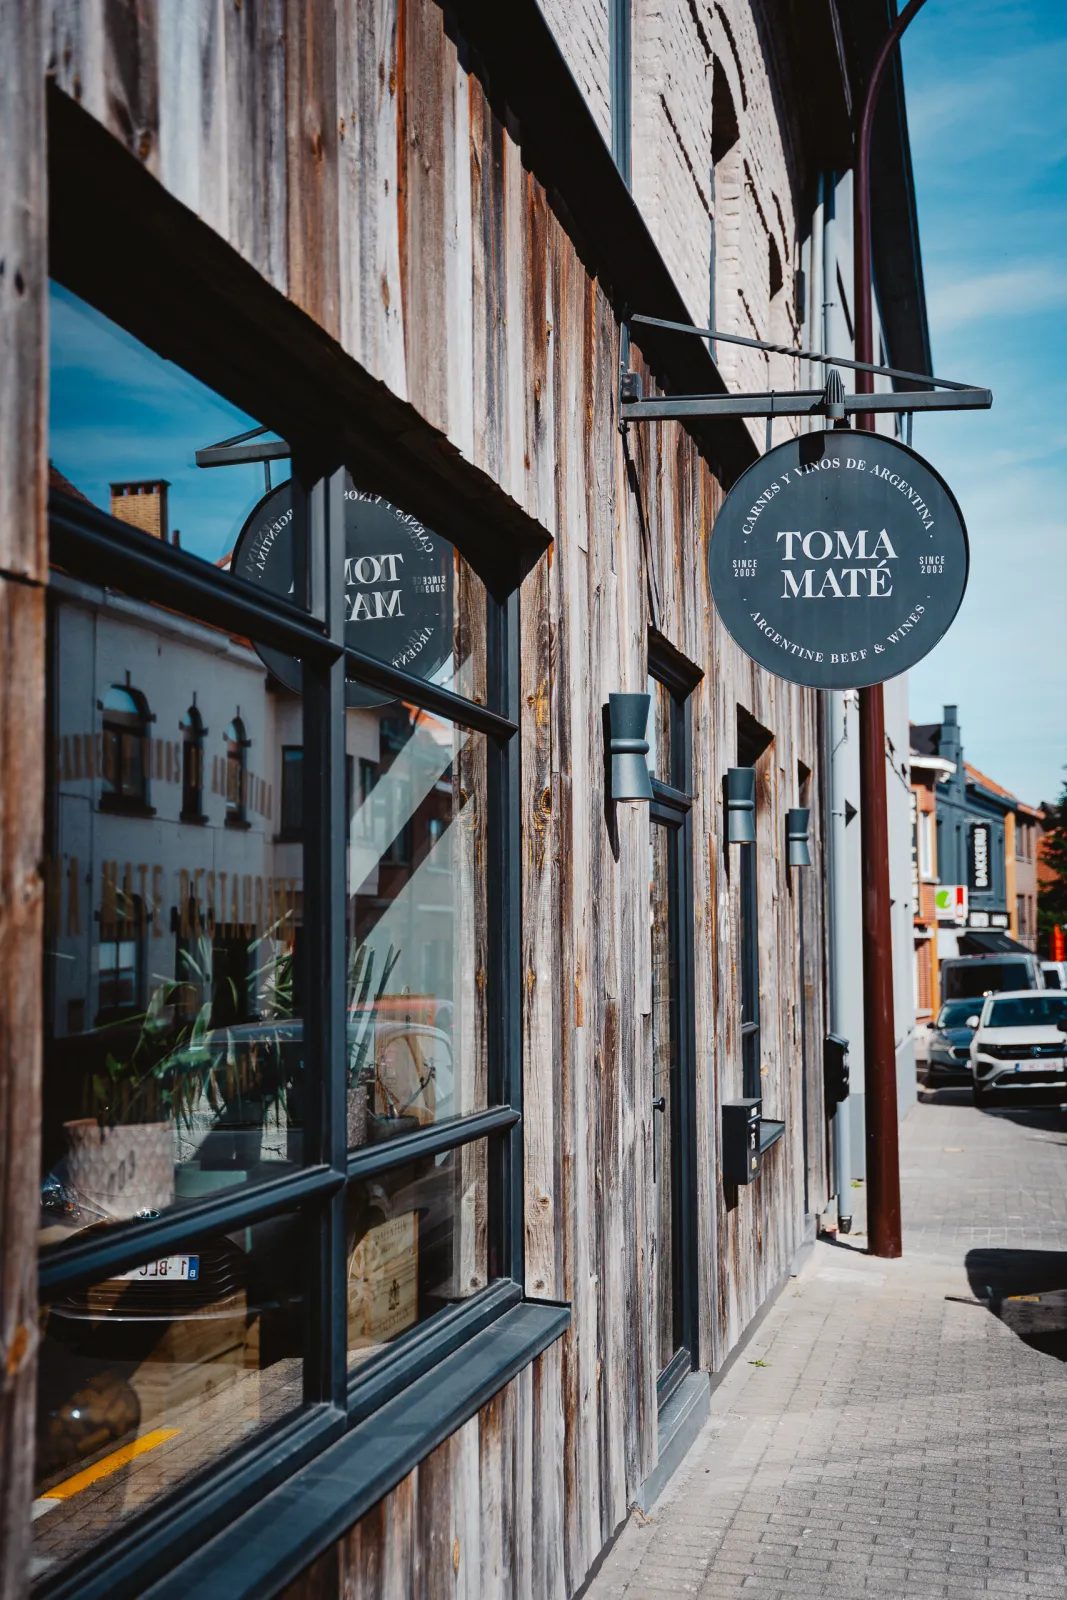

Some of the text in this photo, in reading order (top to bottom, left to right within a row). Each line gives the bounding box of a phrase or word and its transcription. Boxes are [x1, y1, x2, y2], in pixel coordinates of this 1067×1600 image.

[742, 457, 935, 534] CARNES Y VINOS DE ARGENTINA
[776, 528, 899, 561] TOMA
[732, 560, 758, 568] SINCE
[919, 556, 945, 565] SINCE
[921, 565, 944, 574] 2003
[734, 568, 756, 577] 2003
[780, 559, 893, 598] MATÉ
[750, 604, 925, 664] ARGENTINE BEEF & WINES
